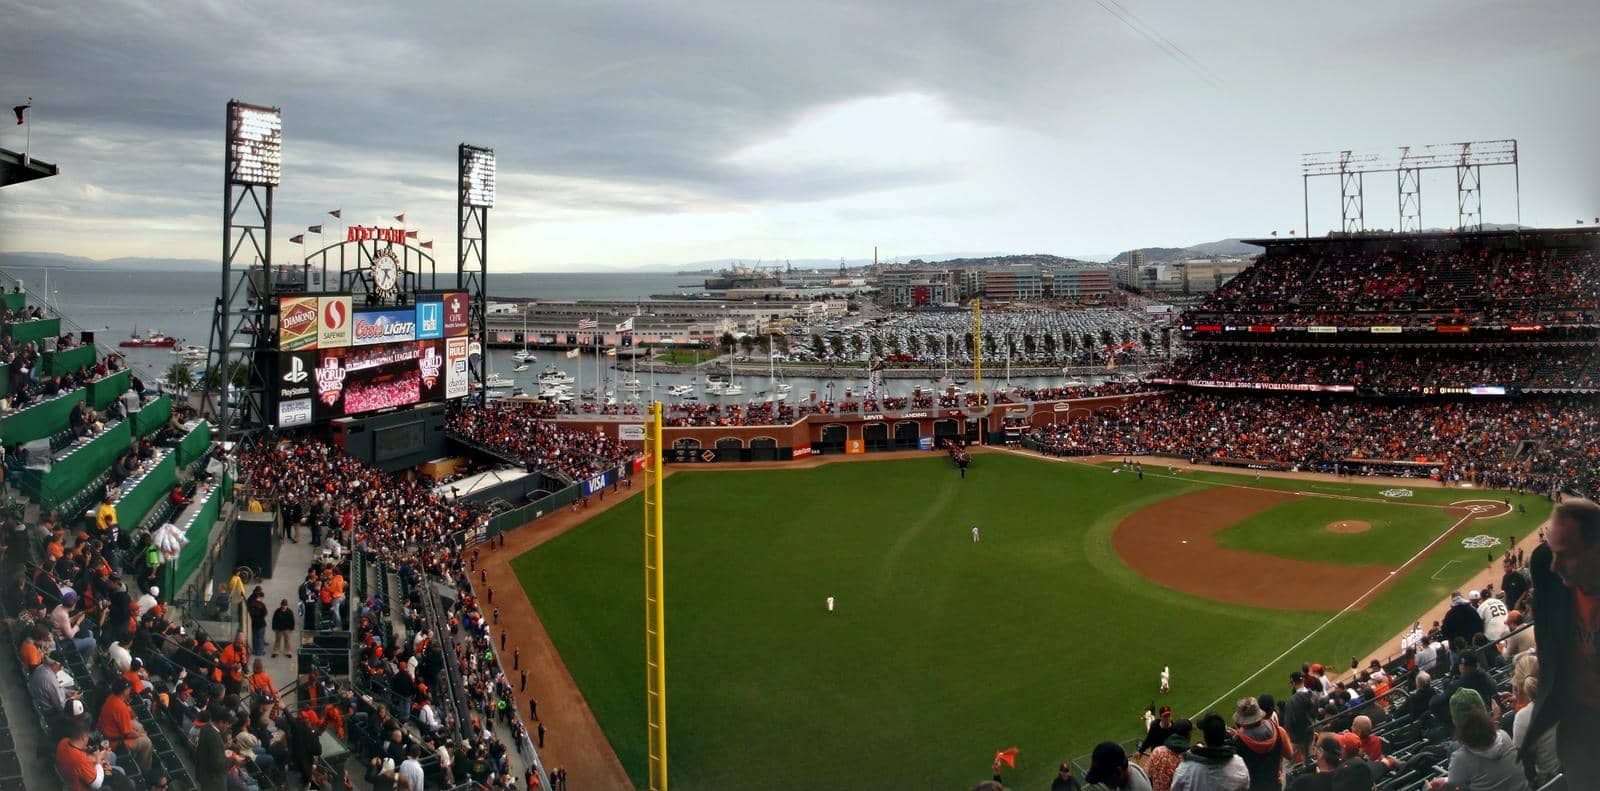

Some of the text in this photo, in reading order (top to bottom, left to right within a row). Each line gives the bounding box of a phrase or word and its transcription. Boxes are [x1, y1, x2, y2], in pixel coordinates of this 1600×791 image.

[347, 227, 406, 246] AT&T PARK
[284, 311, 315, 328] DIAMOND
[355, 319, 413, 339] Coors LIGHT
[450, 346, 465, 356] RULE
[419, 355, 442, 371] WORLD
[315, 368, 346, 383] WORLD
[281, 387, 310, 397] PlayStation
[319, 381, 343, 393] SERIES
[588, 474, 606, 493] VISA
[1490, 605, 1507, 617] 25
